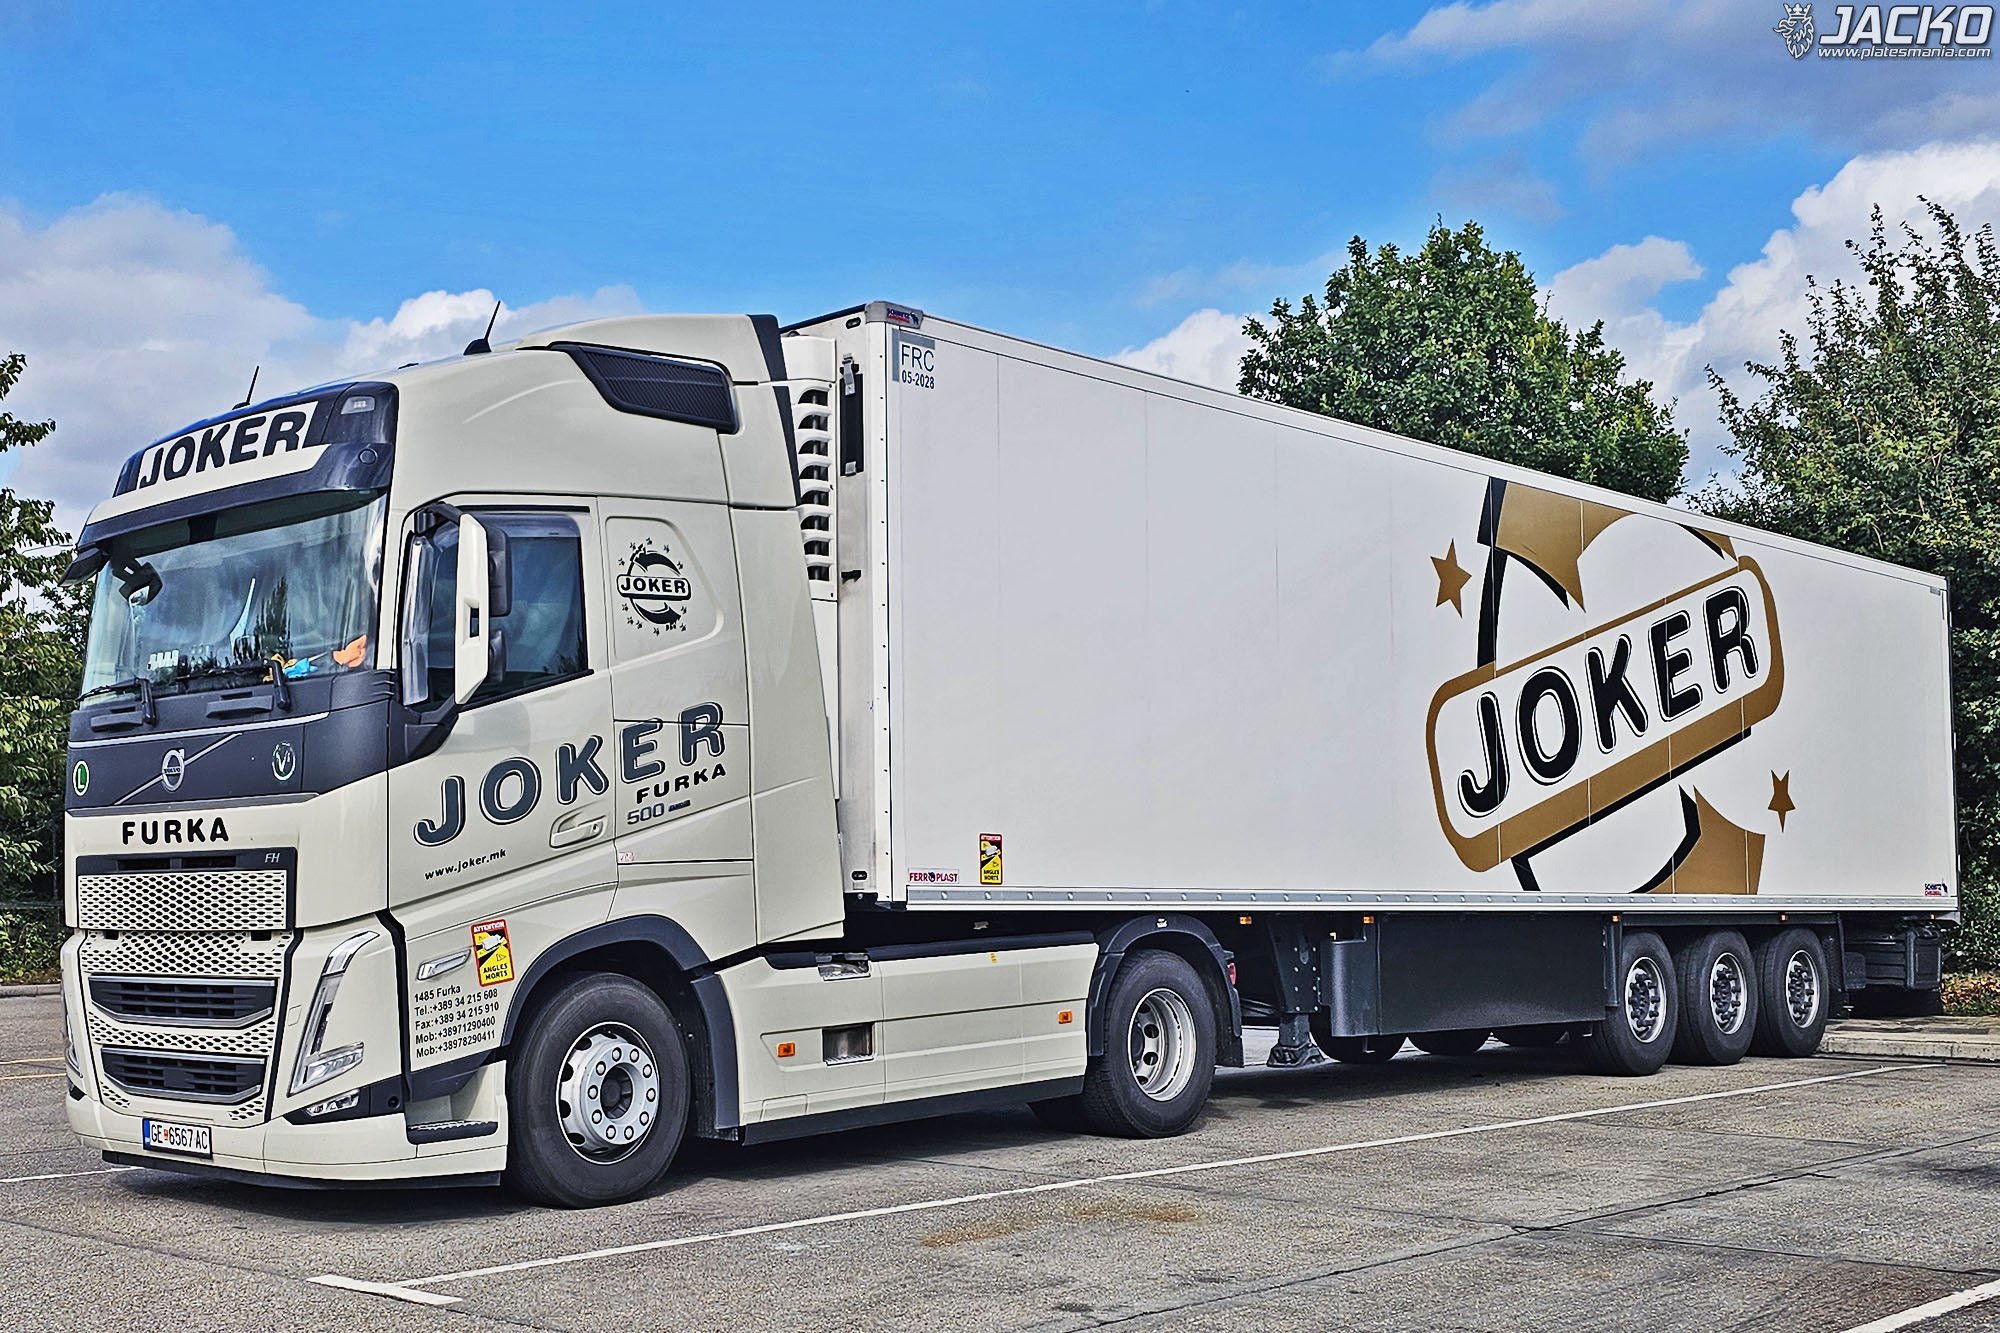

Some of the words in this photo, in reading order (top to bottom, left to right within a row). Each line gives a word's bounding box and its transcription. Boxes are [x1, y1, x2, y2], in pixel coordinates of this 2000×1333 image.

[901, 344, 935, 372] FRC
[901, 369, 935, 389] 05-2028
[139, 411, 307, 489] JOKER
[620, 577, 686, 594] JOKER
[1457, 586, 1759, 818] JOKER
[413, 702, 726, 847] JOKER
[636, 763, 726, 804] FURKA
[627, 802, 665, 825] 500
[122, 816, 229, 845] FURKA
[264, 852, 281, 864] FH
[424, 848, 507, 880] www.joker.mk
[483, 963, 508, 974] ANGLES
[485, 970, 508, 981] MORTS
[414, 989, 435, 1003] 1485
[436, 984, 461, 998] Furka
[454, 996, 465, 1007] 34
[467, 991, 482, 1005] 215
[483, 988, 498, 1000] 608
[415, 1012, 454, 1031] Fax:+389
[456, 1009, 466, 1021] 34
[468, 1005, 483, 1018] 215
[484, 1001, 500, 1013] 910
[151, 1124, 163, 1144] GE
[169, 1126, 194, 1148] 6567
[196, 1130, 208, 1150] AC
